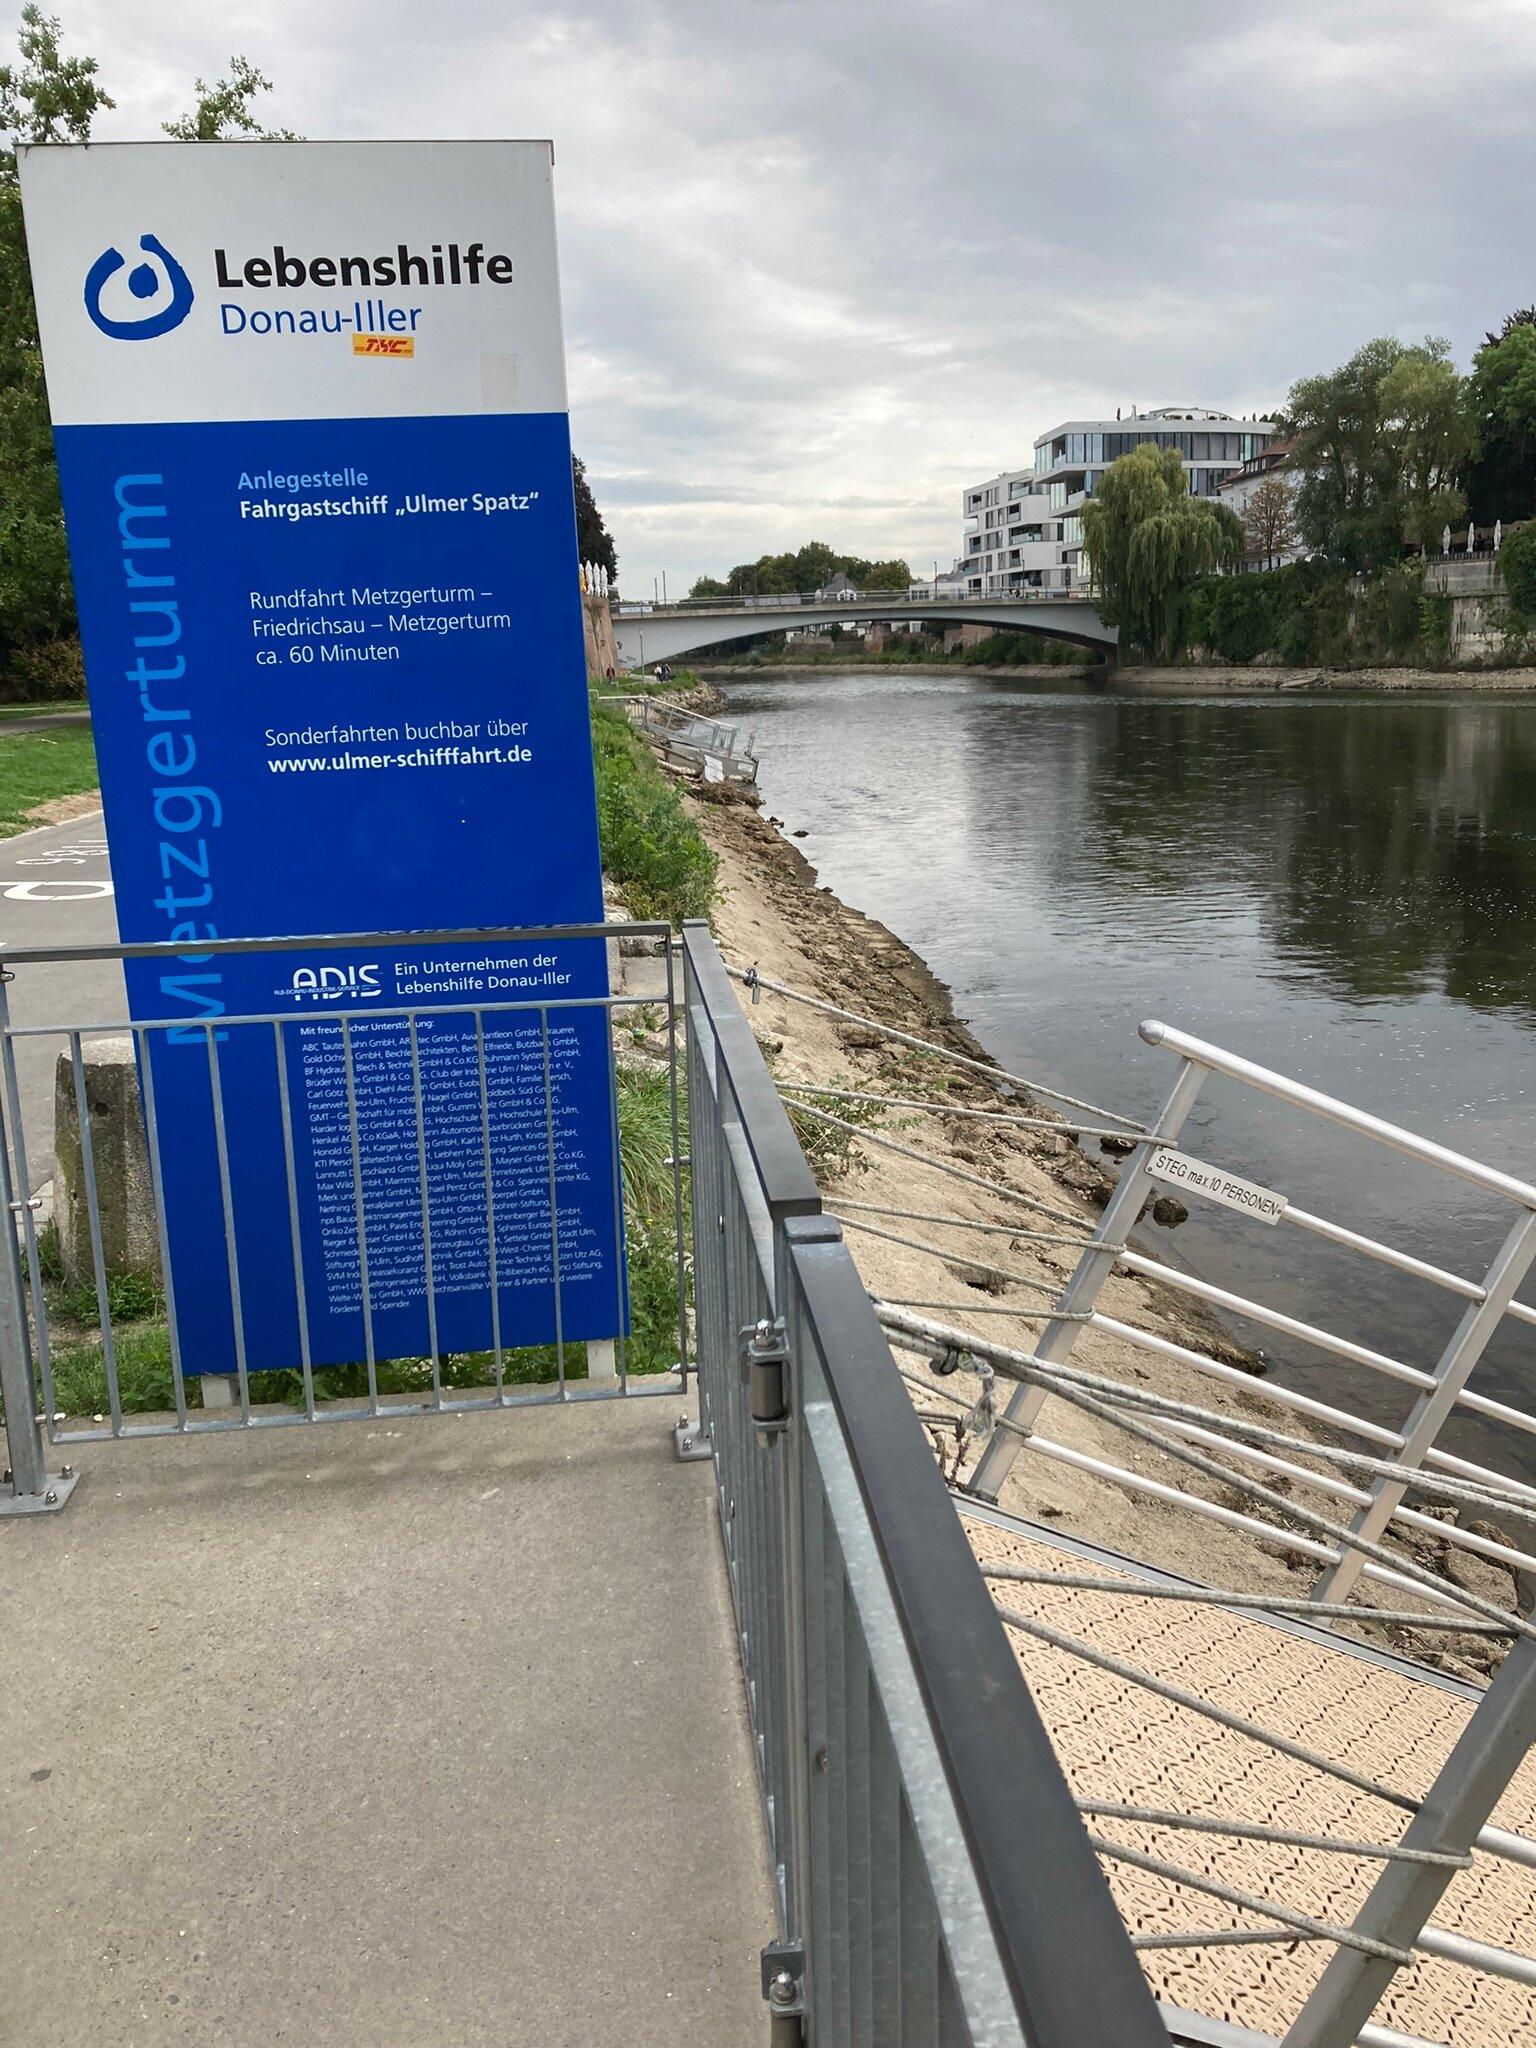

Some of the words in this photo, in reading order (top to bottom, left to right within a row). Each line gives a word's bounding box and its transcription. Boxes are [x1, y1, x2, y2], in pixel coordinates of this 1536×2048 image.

[214, 243, 514, 288] Lebenshilfe
[220, 299, 422, 334] Donau-Iller
[237, 469, 369, 494] Anlegestelle
[240, 496, 389, 522] Fahrgastschiff
[250, 588, 346, 610] Rundfahrt
[351, 585, 475, 610] Metzgerturm
[252, 616, 365, 638] Friedrichsau
[388, 612, 511, 636] Metzgerturm
[255, 648, 283, 666] ca.
[288, 644, 314, 664] 60
[320, 642, 400, 663] Minuten
[265, 724, 399, 748] Sonderfahrten
[405, 720, 481, 742] buchbar
[486, 719, 529, 738] über
[114, 473, 229, 1043] Metzgerturm
[267, 745, 532, 774] www.ulmer-schifffahrt.de
[394, 962, 419, 977] Ein
[423, 956, 530, 974] Unternehmen
[533, 953, 558, 968] der
[293, 964, 382, 1001] ADIS
[396, 976, 483, 995] Lebenshilfe
[488, 972, 572, 989] Donau-Iller
[300, 1027, 315, 1035] Mit
[1156, 1155, 1188, 1178] STEG
[1221, 1182, 1280, 1216] PERSONEN
